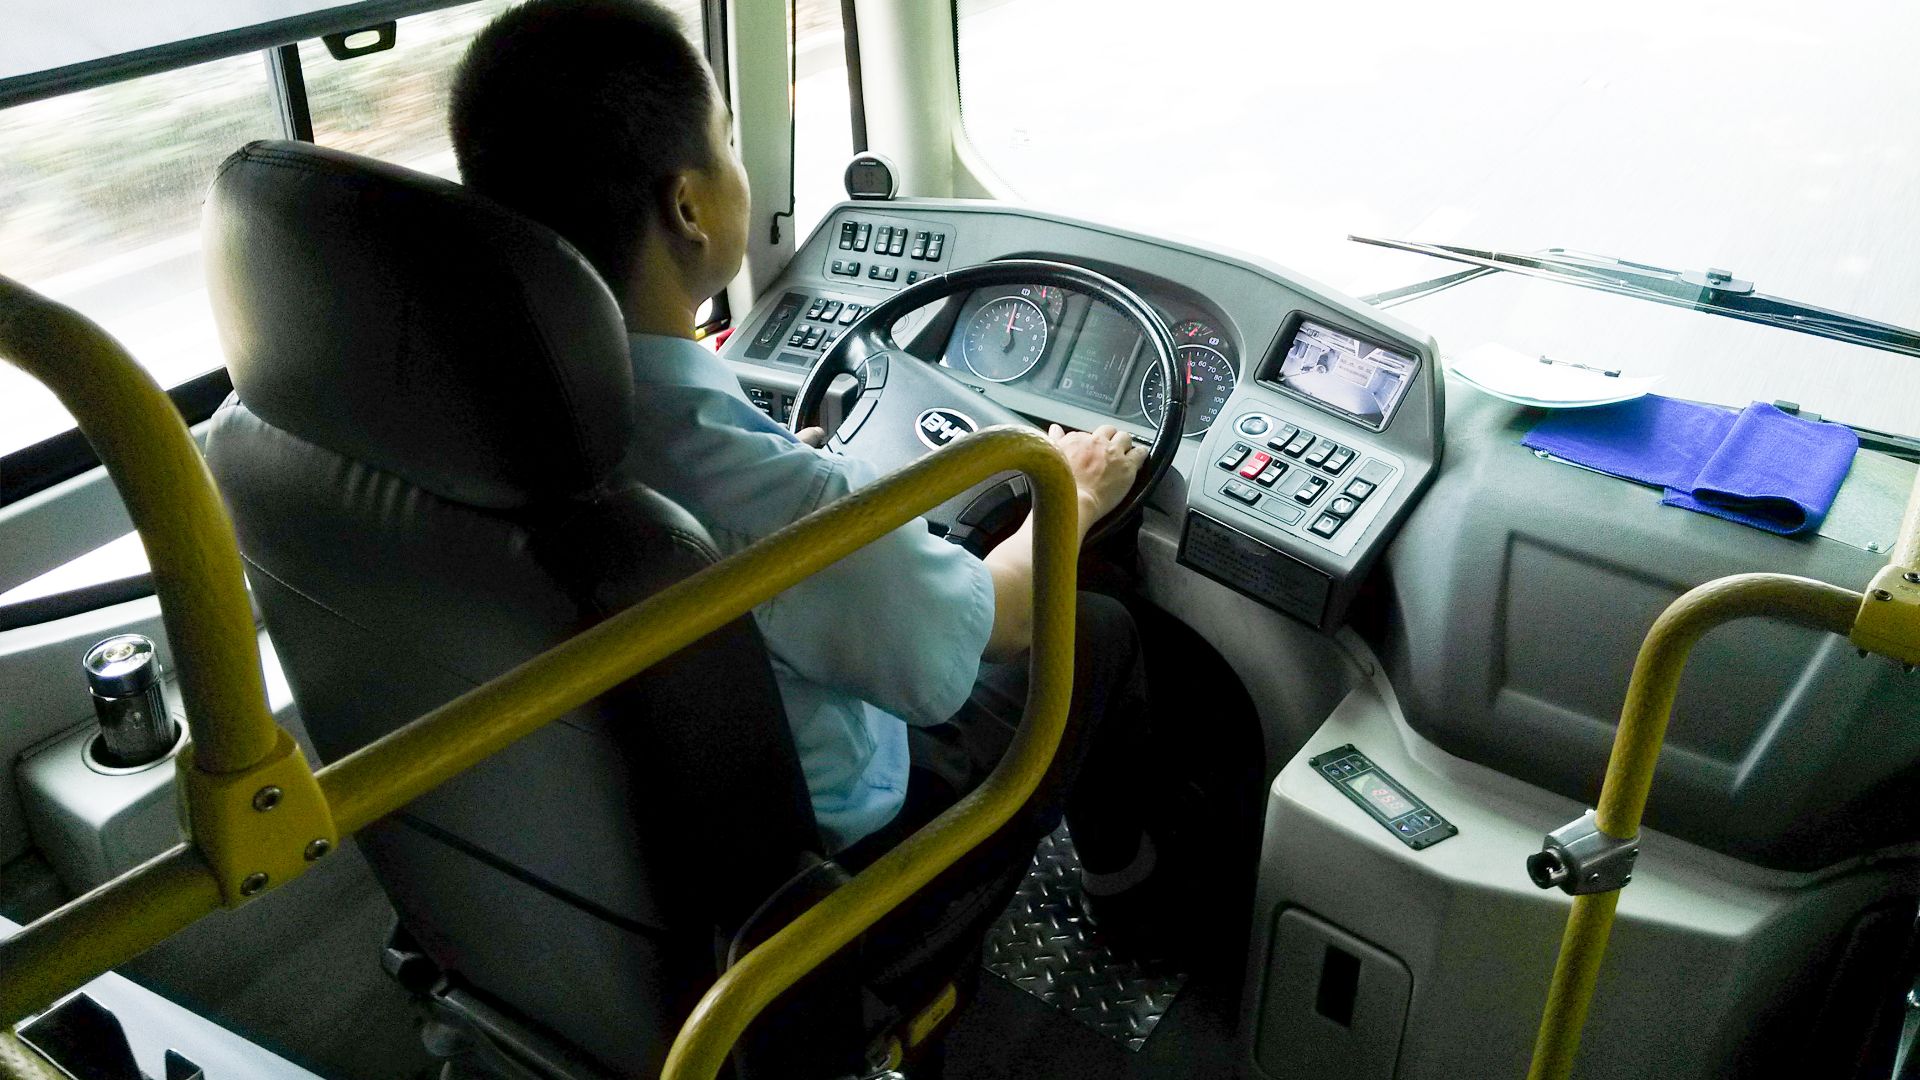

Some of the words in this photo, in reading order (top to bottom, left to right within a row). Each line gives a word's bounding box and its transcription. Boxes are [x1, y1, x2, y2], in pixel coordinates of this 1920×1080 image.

[1352, 481, 1366, 498] R
[1334, 498, 1352, 514] N
[1317, 516, 1334, 530] D
